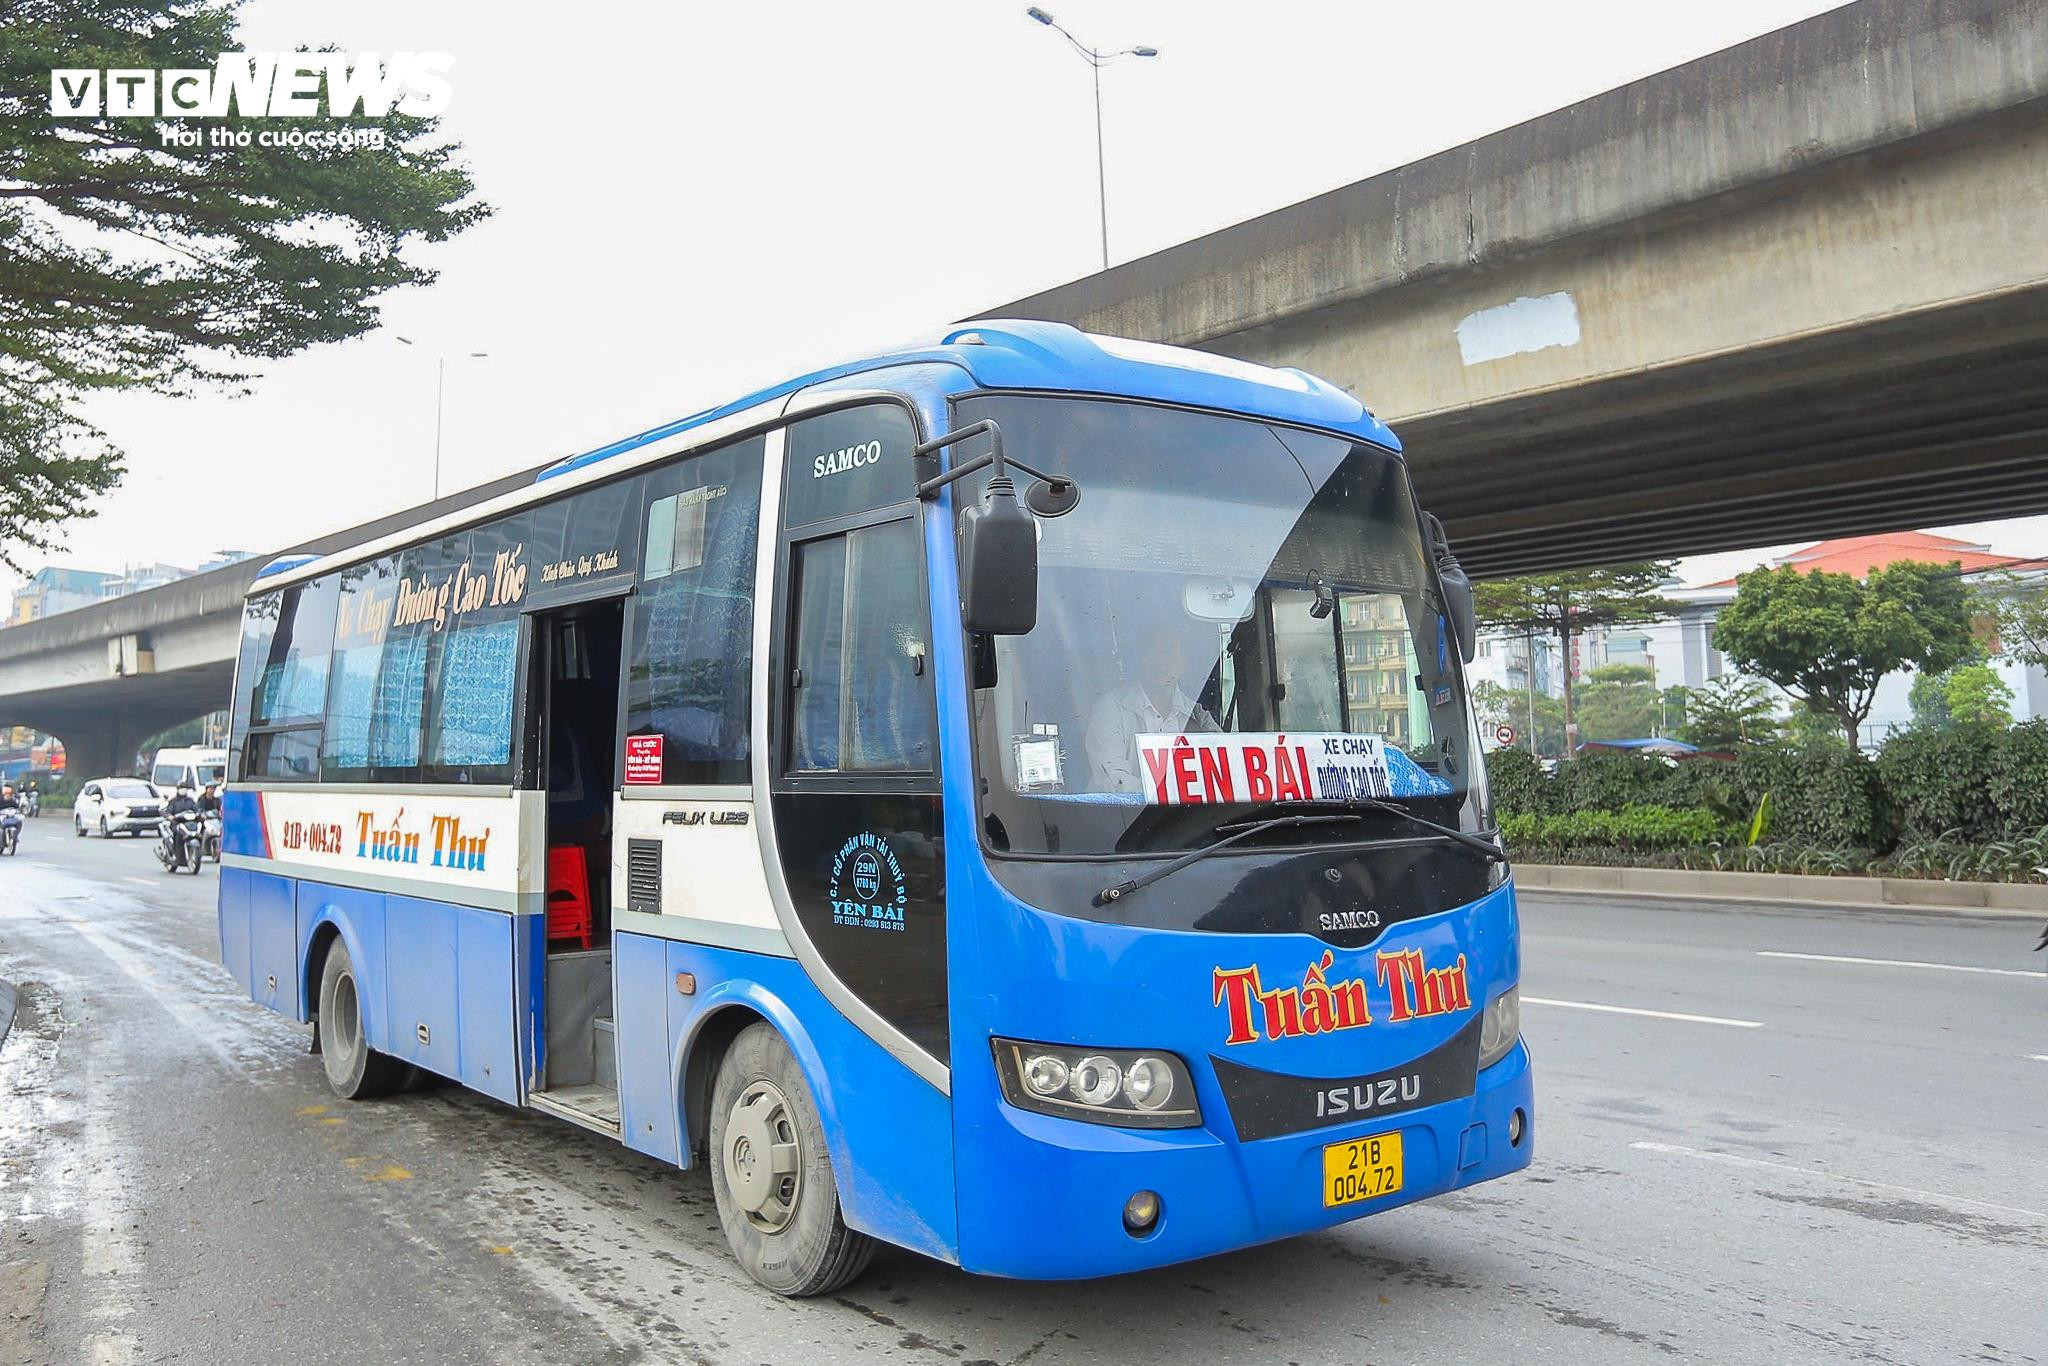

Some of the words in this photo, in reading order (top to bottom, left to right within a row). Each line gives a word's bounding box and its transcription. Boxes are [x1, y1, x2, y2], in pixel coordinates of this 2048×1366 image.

[813, 440, 881, 478] SAMCO
[452, 558, 487, 615] Cao
[490, 542, 529, 607] Tốc
[1322, 738, 1341, 755] XE
[1342, 738, 1374, 758] CHẠY
[1143, 735, 1235, 805] YÊN
[1242, 735, 1313, 801] BÁI
[1350, 766, 1372, 799] CAO
[1368, 757, 1390, 797] TỐC
[356, 807, 420, 864] Tuấn
[430, 812, 490, 872] Thư
[859, 831, 875, 849] VẬN
[877, 836, 888, 857] TẢI
[857, 862, 876, 874] 29N
[831, 899, 867, 917] YÊN
[871, 903, 904, 921] BÁI
[1319, 910, 1380, 931] SAMCO
[1212, 949, 1373, 1046] Tuấn
[1376, 947, 1472, 1022] Thư
[1316, 1075, 1420, 1117] ISUZU
[1348, 1140, 1381, 1170] 21B
[1334, 1165, 1395, 1202] 004.72
